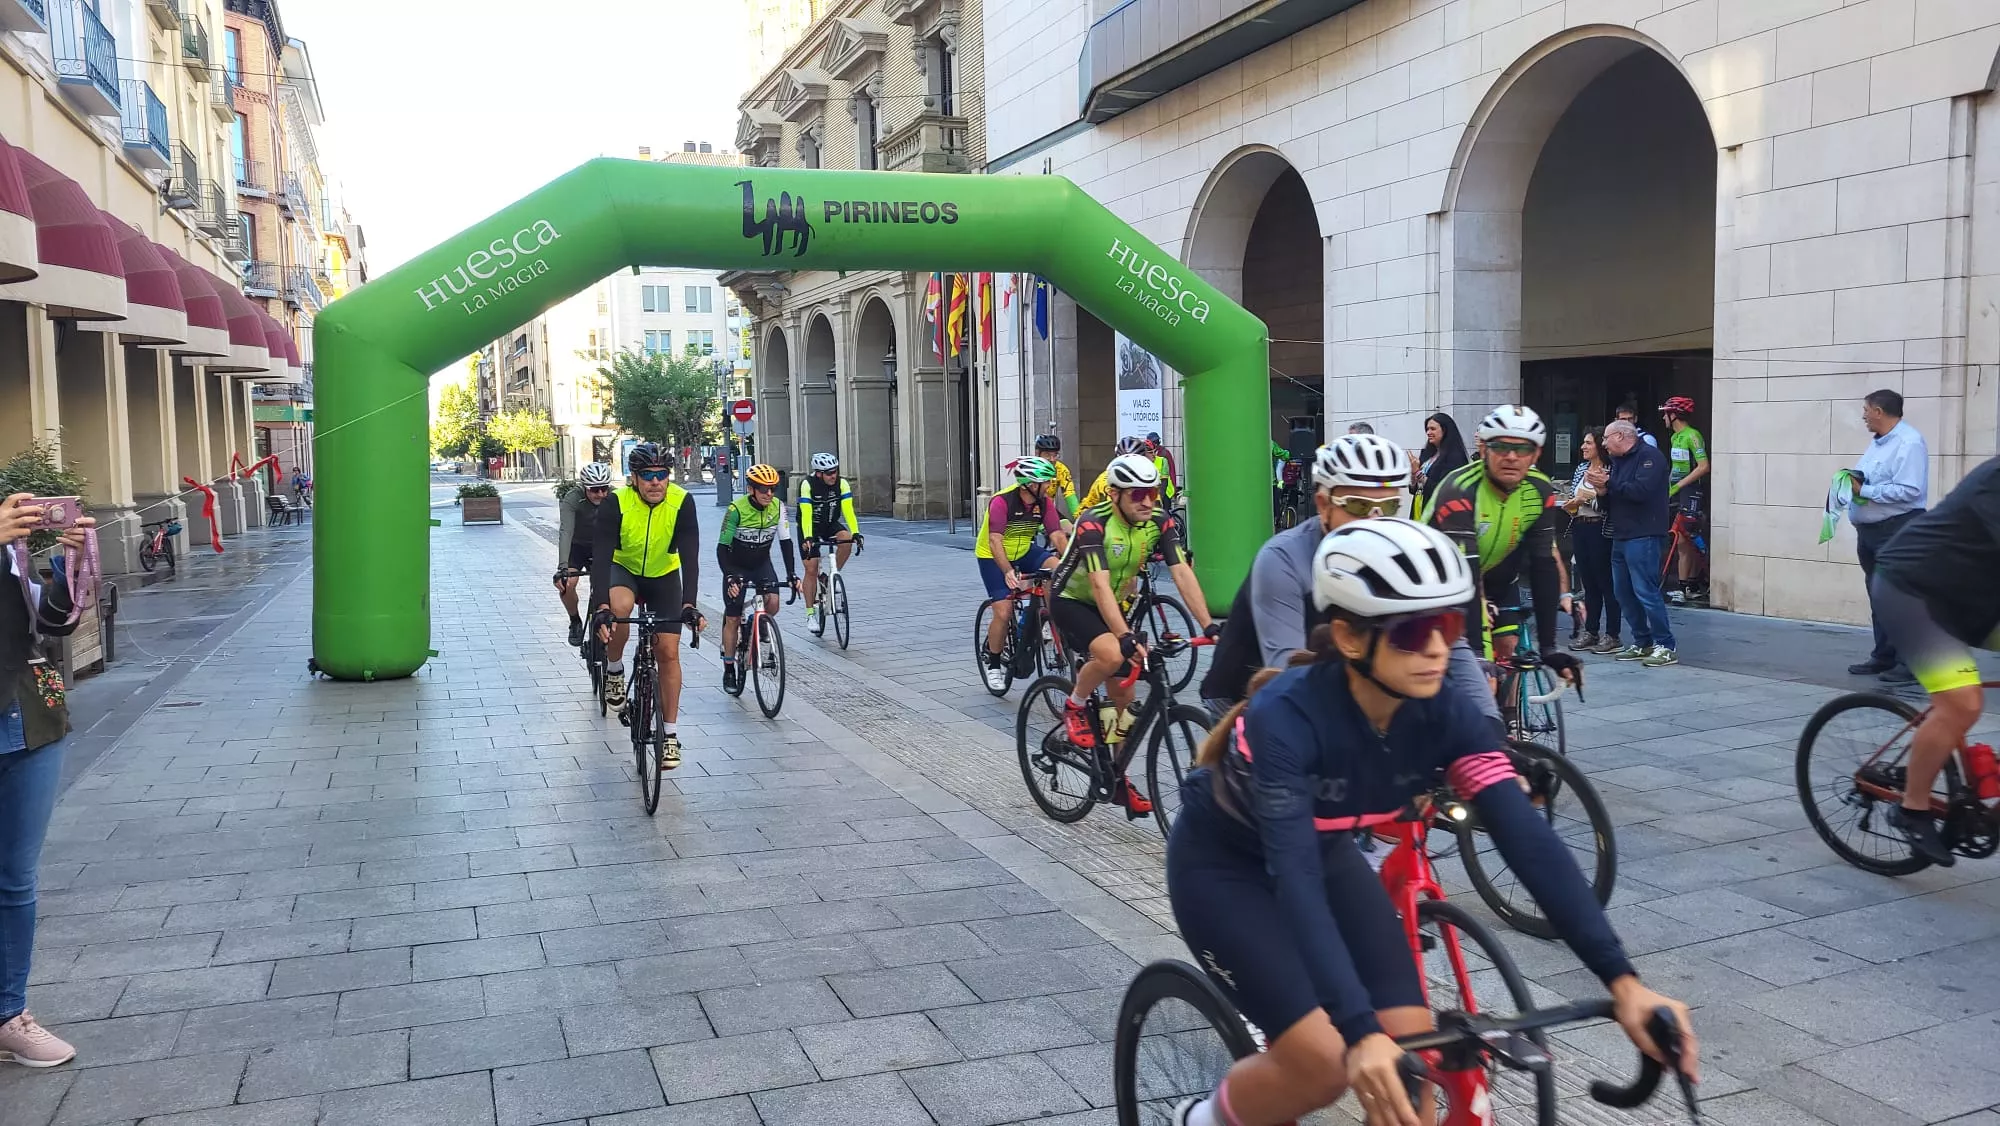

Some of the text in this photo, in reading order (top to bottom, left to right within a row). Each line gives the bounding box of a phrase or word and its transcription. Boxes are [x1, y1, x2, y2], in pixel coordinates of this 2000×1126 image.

[823, 200, 959, 225] PIRINEOS
[1132, 399, 1151, 409] VIAJES
[1132, 410, 1160, 422] UTÓPICOS
[738, 532, 774, 542] huesc
